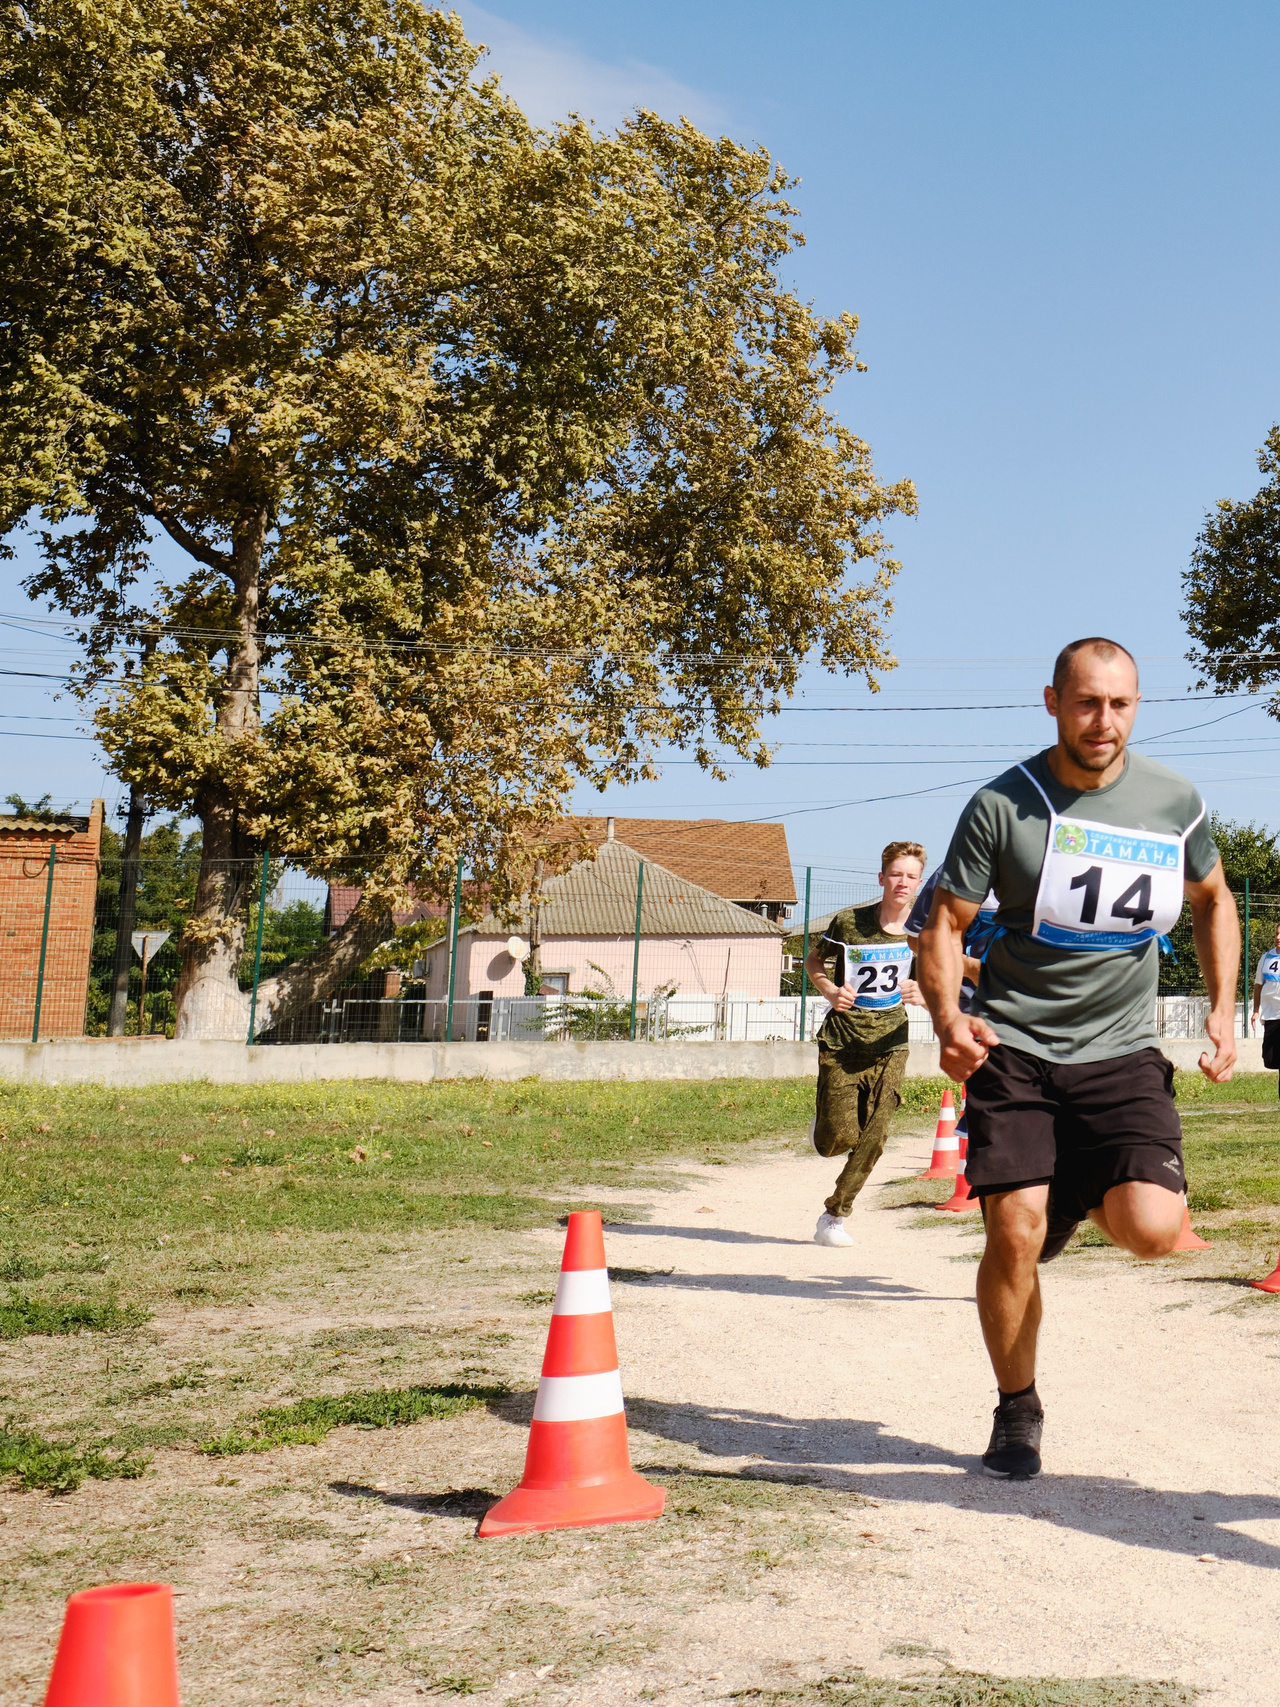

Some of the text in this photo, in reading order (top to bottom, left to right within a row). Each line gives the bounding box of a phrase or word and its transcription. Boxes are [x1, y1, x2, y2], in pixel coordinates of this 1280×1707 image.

[1089, 839, 1177, 866] ТАМАНЬ
[1070, 865, 1155, 926] 14
[863, 951, 910, 961] ТАМАНЬ
[1269, 961, 1279, 972] 4
[857, 965, 899, 993] 23
